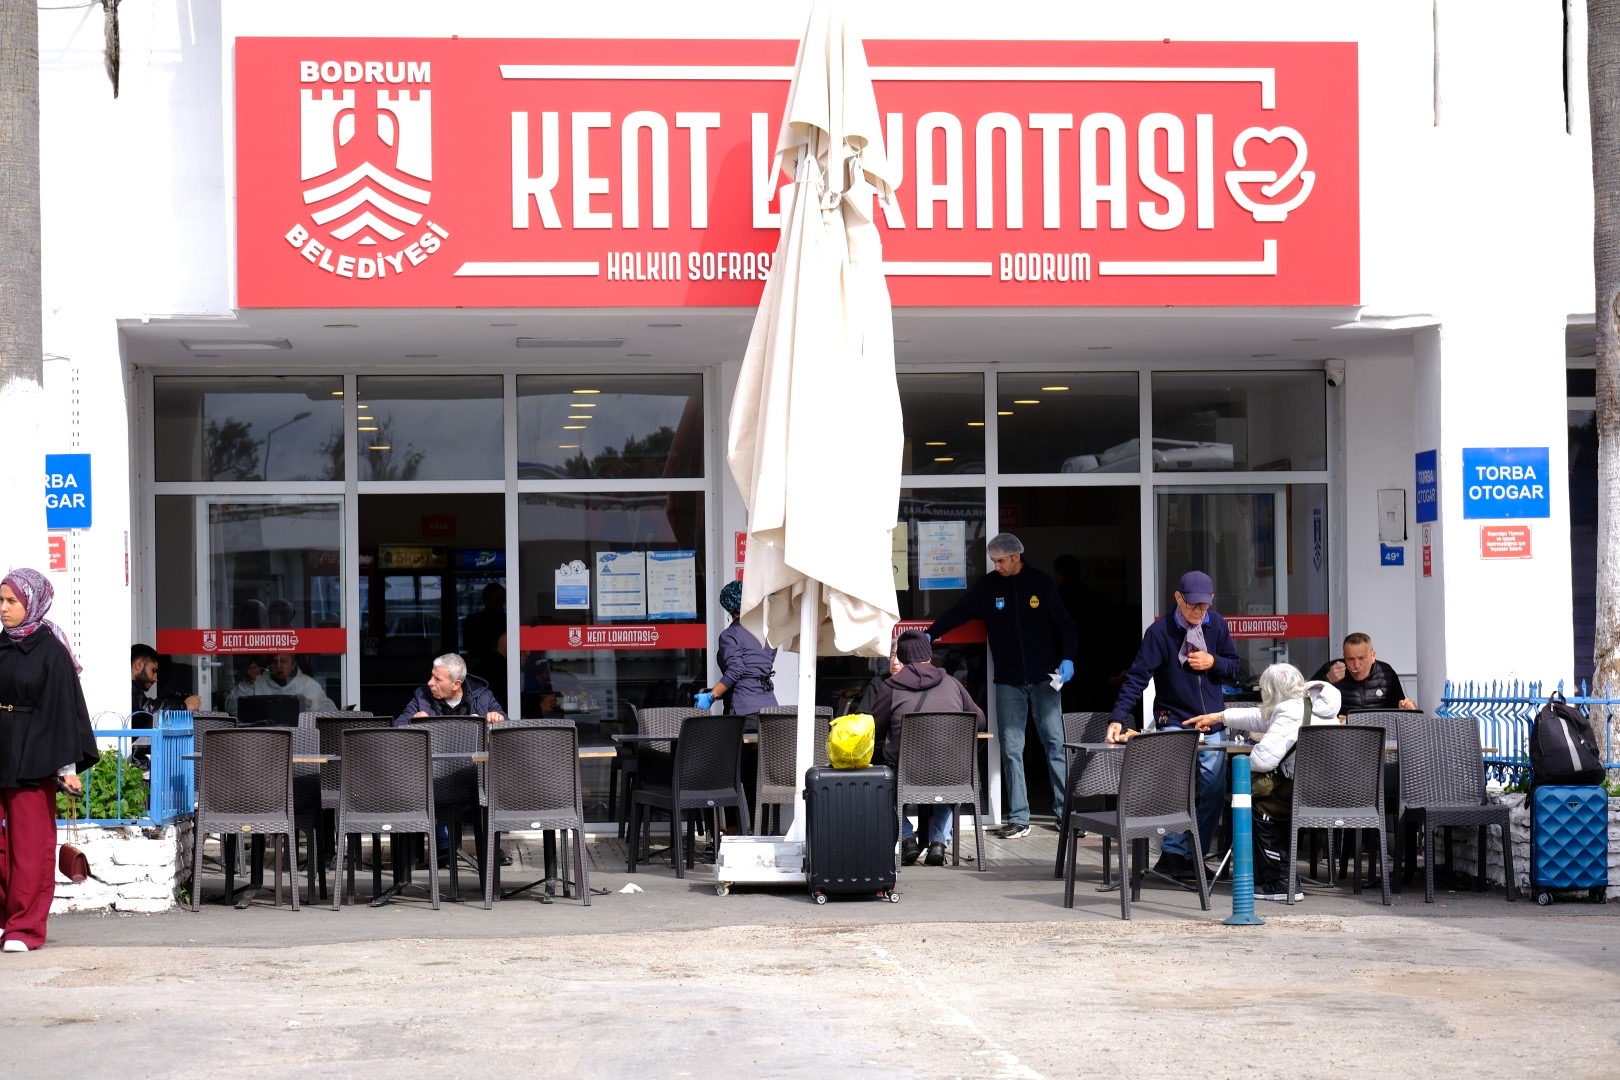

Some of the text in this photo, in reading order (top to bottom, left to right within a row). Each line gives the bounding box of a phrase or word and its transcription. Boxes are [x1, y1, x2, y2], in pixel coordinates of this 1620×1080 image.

[300, 61, 431, 83] BODRUM
[511, 110, 1215, 231] KENT LKANTASI
[285, 220, 449, 279] BELEDİYESİ
[607, 251, 776, 281] HALKIN SOFRAS
[1000, 252, 1091, 281] BODRUM
[1418, 469, 1434, 485] TORBA
[1475, 465, 1537, 480] TORBA
[45, 473, 78, 489] RBA
[1416, 488, 1436, 504] OTOGAR
[1468, 484, 1545, 500] OTOGAR
[46, 493, 86, 509] GAR
[1238, 620, 1280, 632] LOKANTASI
[222, 635, 290, 647] KENT LOKANTASI
[587, 631, 651, 642] KENT LOKANTASI
